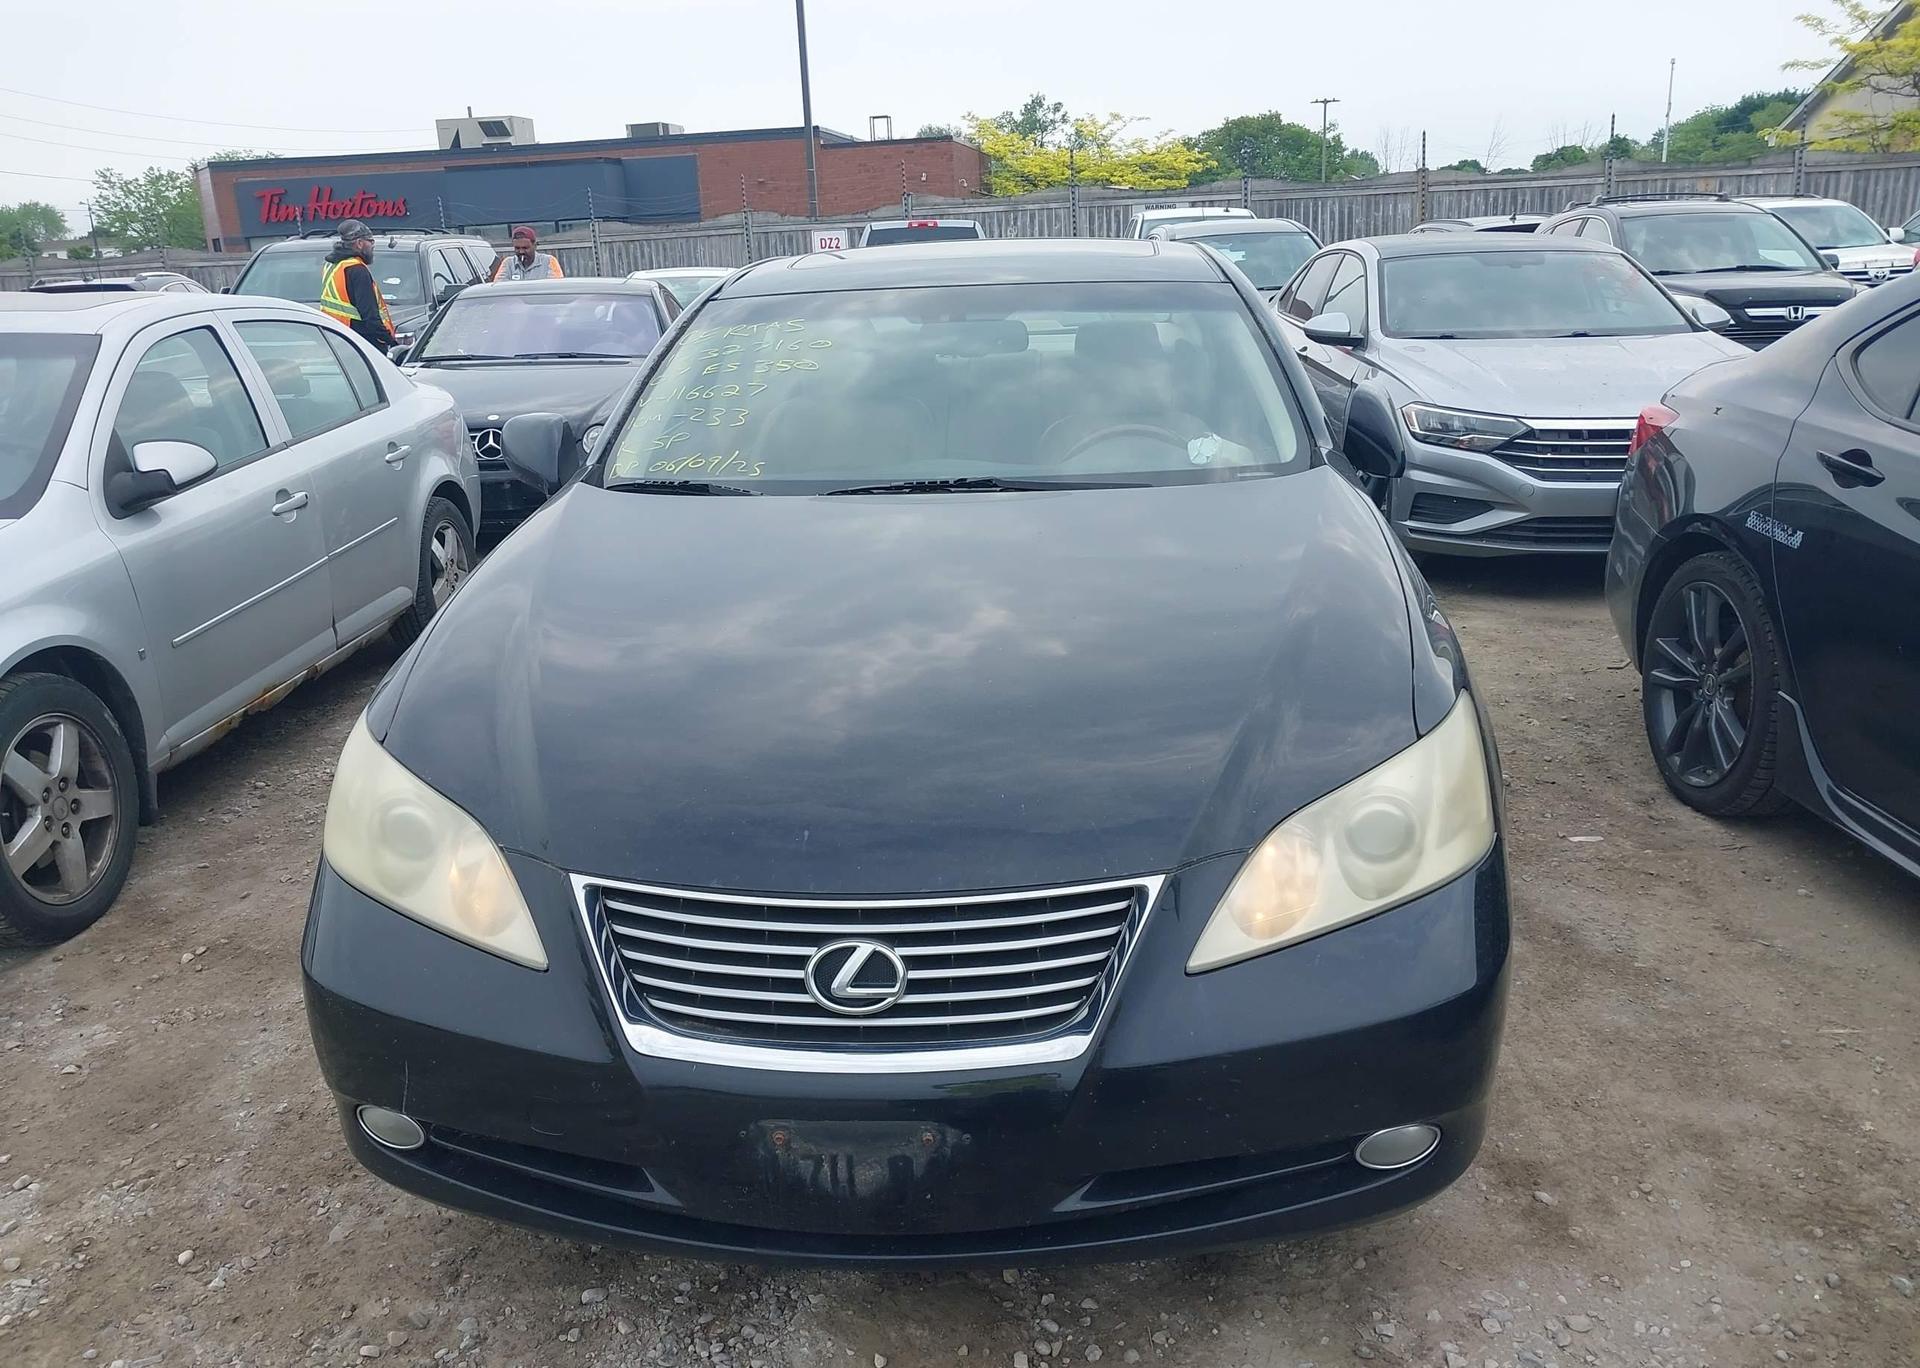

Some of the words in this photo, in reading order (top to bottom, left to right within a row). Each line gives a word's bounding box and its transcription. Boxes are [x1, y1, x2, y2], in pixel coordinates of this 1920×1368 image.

[255, 188, 304, 224] Tim
[307, 184, 408, 223] Hortons
[819, 237, 841, 250] DZ2
[753, 359, 820, 373] 350
[648, 450, 766, 477] 06/09/25
